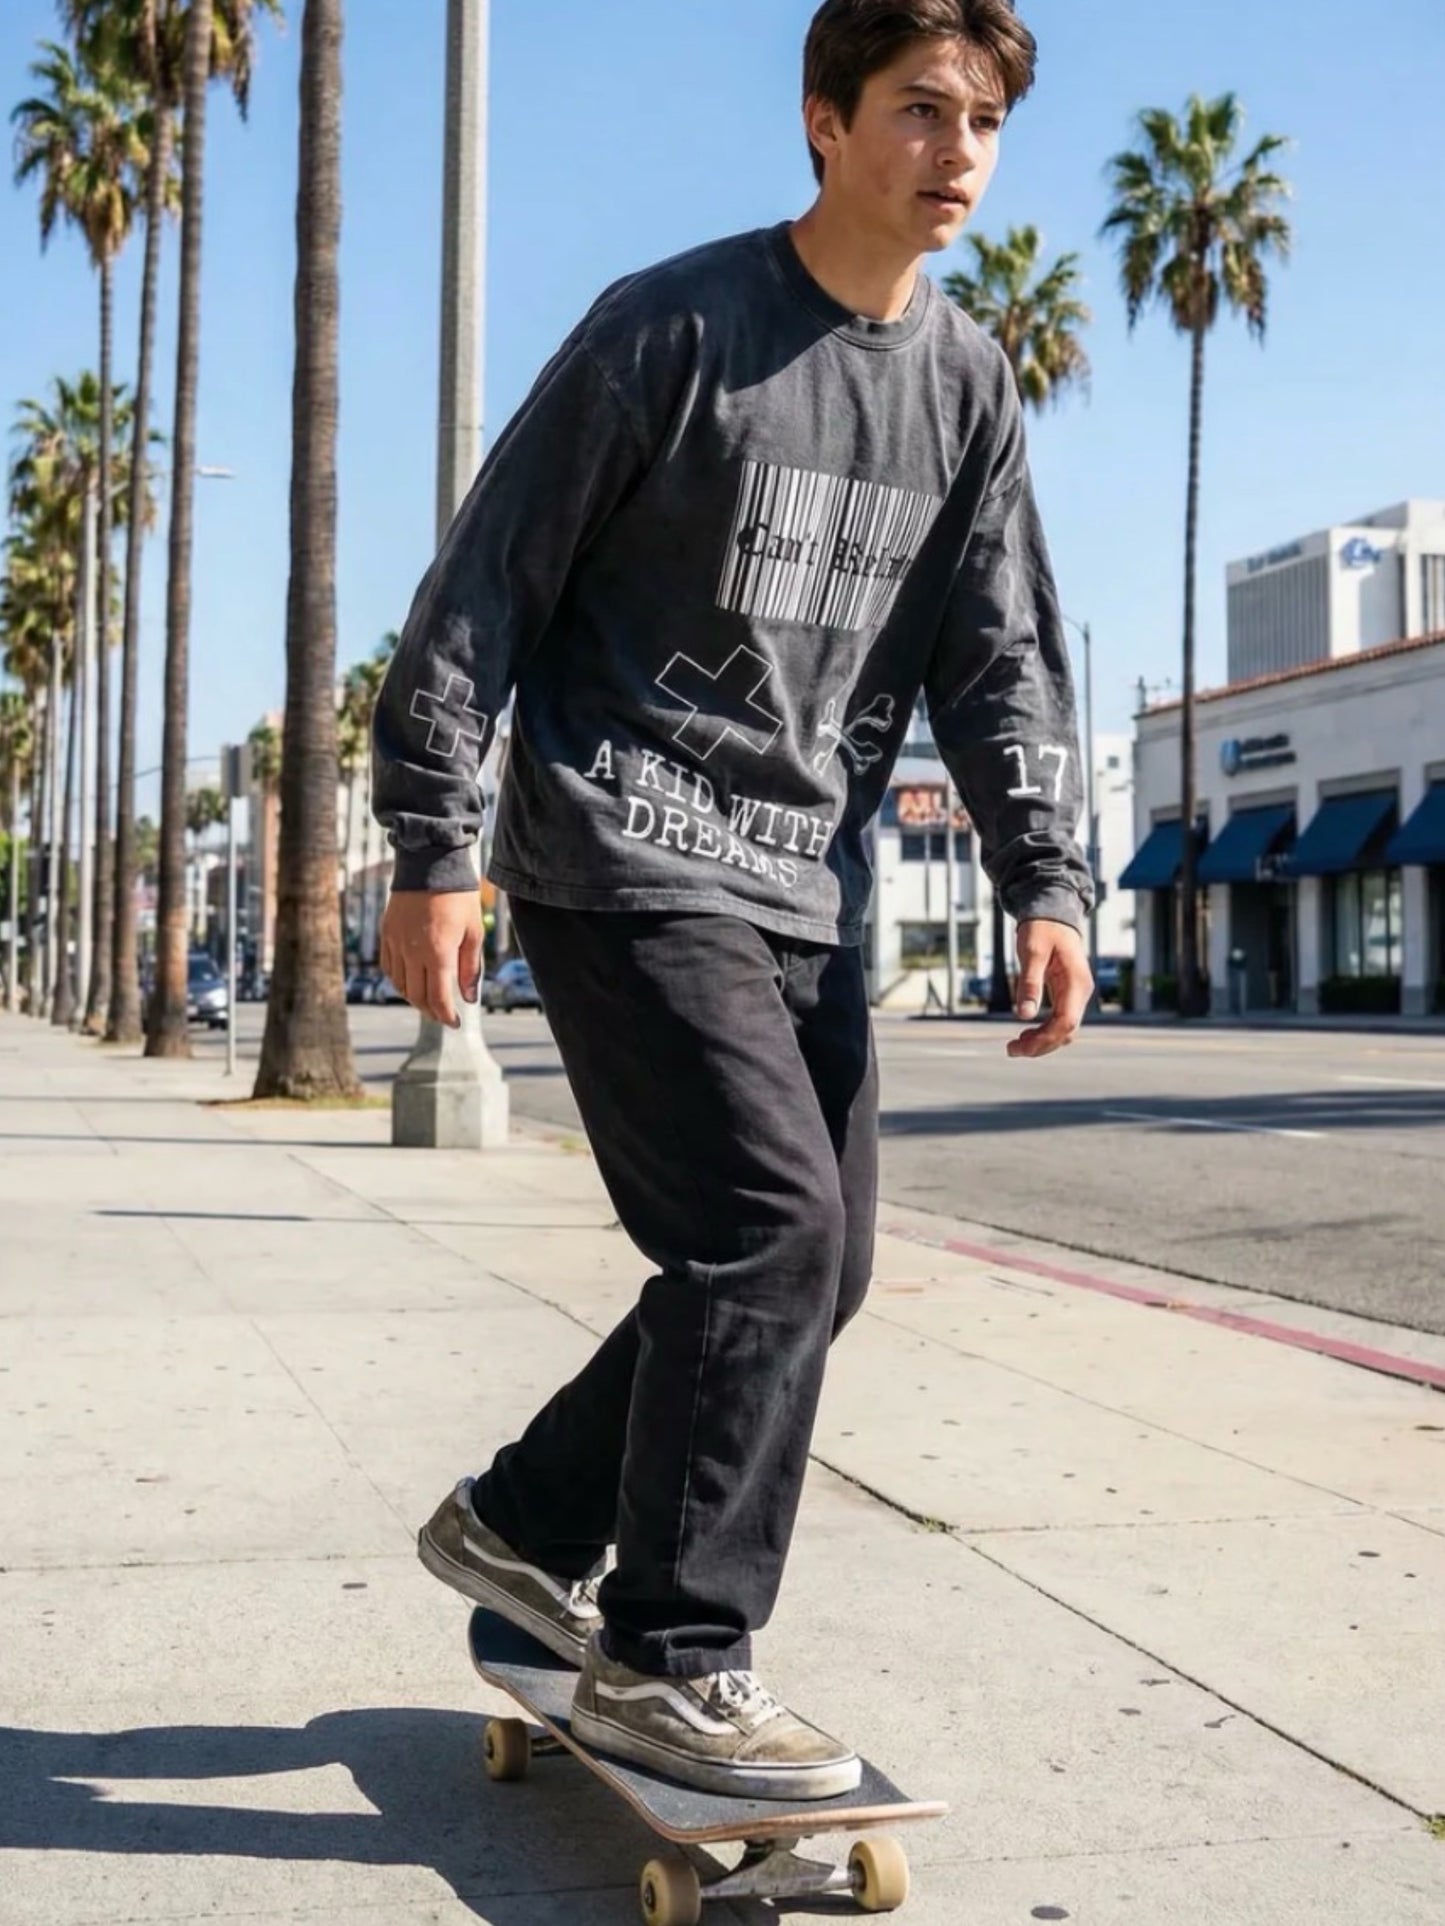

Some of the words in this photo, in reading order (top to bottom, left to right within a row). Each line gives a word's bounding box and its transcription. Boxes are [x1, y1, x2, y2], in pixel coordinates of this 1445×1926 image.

[737, 522, 818, 566] Can't
[584, 739, 616, 780] A
[636, 749, 714, 815] KID
[729, 794, 833, 857] WITH
[1003, 744, 1068, 802] 17
[622, 796, 798, 887] DREAMS
